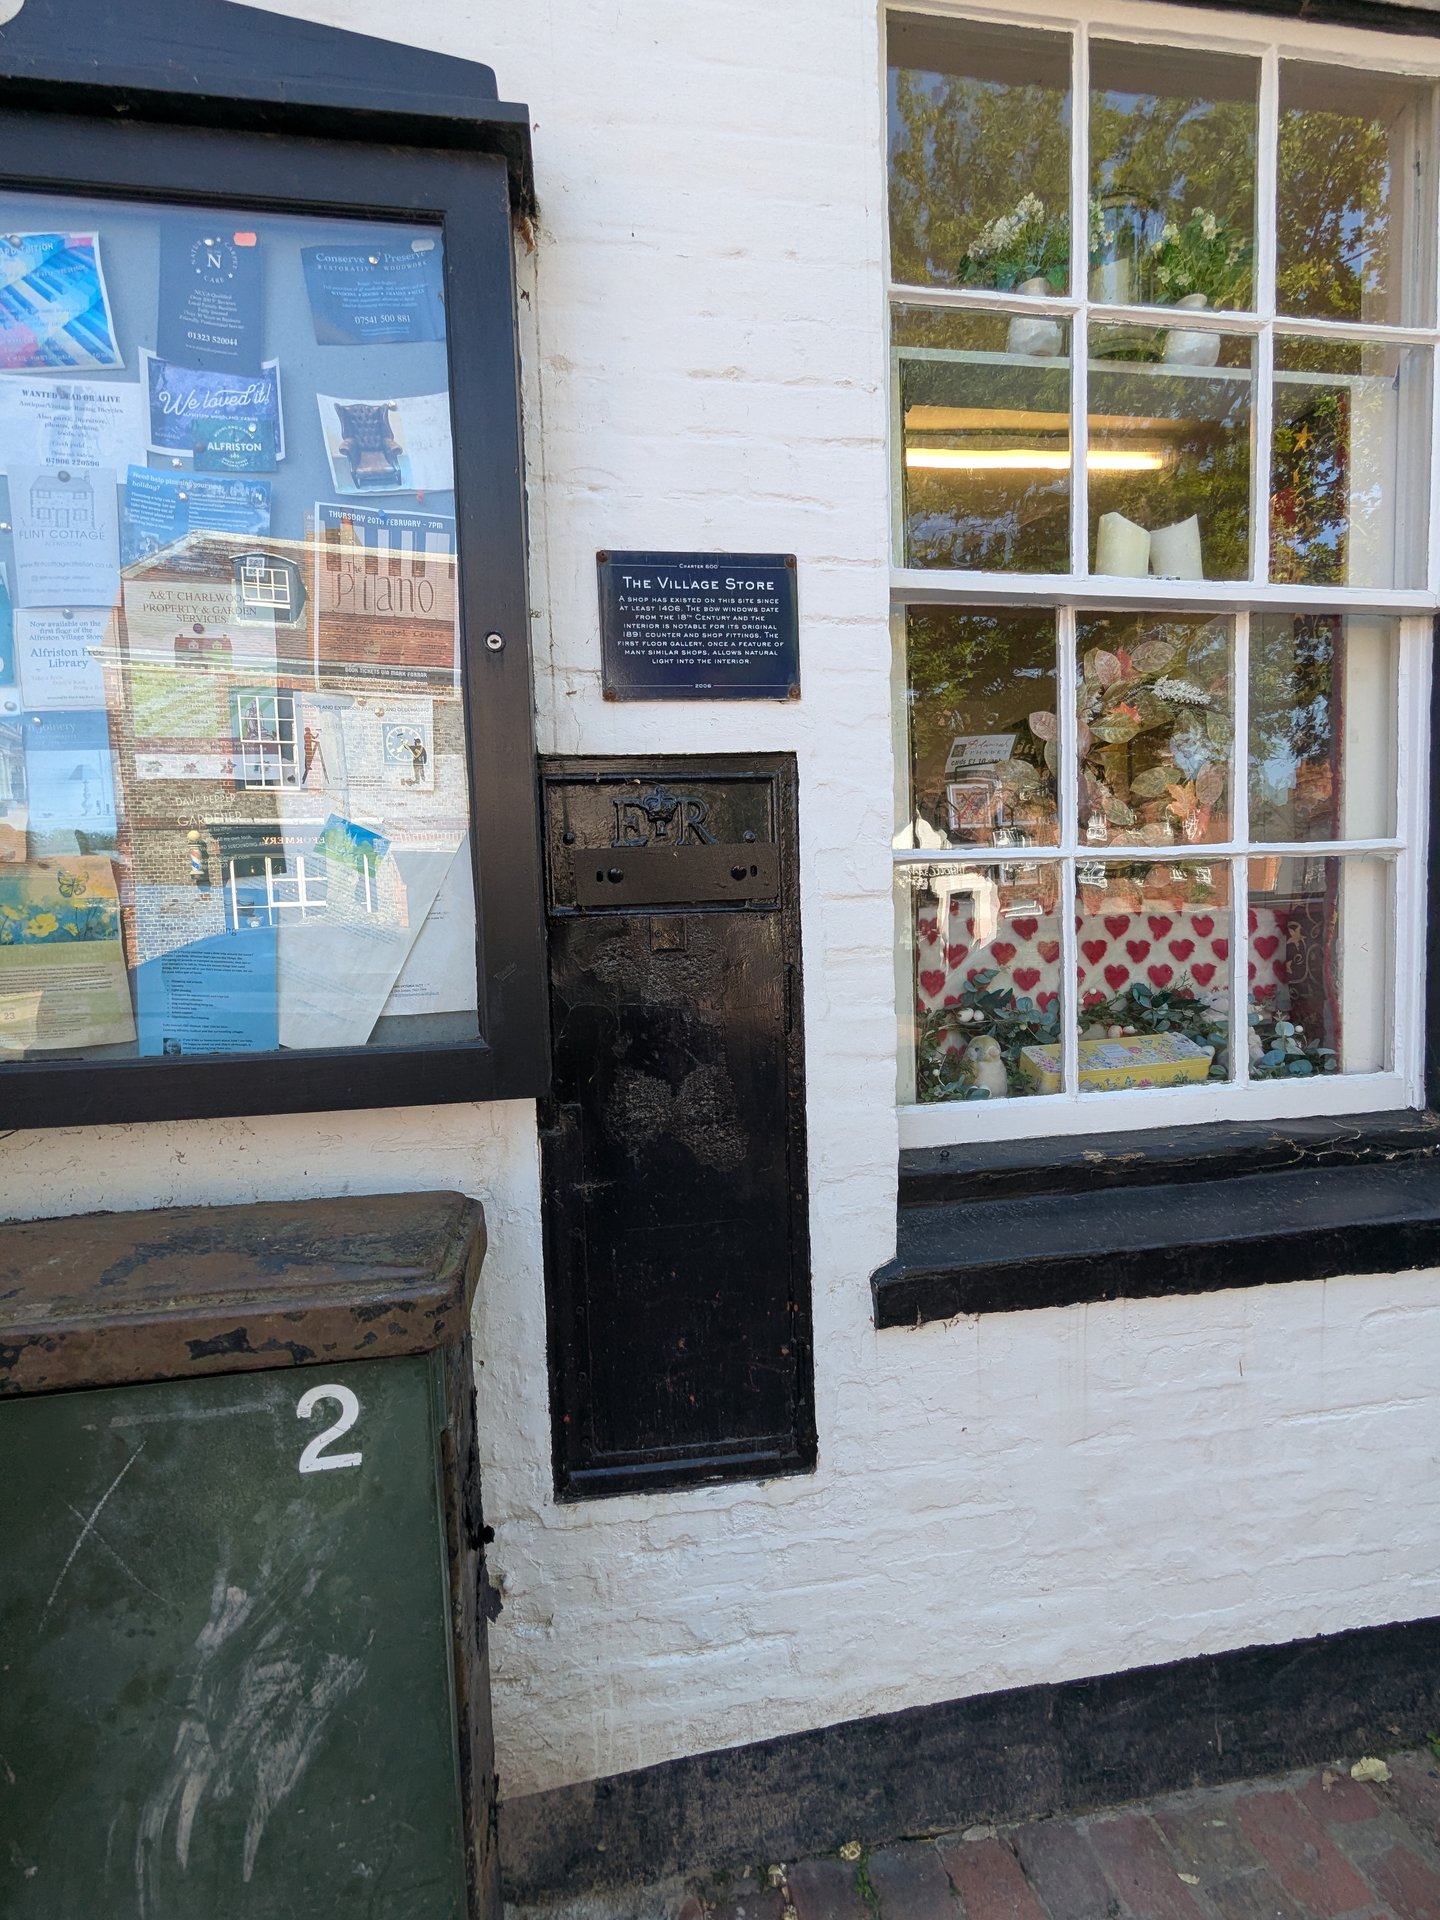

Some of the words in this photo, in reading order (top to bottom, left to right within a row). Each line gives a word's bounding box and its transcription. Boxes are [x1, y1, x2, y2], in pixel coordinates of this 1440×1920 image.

[315, 252, 365, 264] Conserve
[354, 316, 377, 325] 07541
[380, 315, 395, 323] 500
[397, 314, 410, 323] 881
[187, 331, 211, 342] 01323
[212, 334, 238, 347] 520044
[21, 389, 58, 400] WANTED
[97, 394, 121, 403] ALIVE
[159, 389, 201, 416] We
[203, 384, 254, 409] loved
[207, 441, 262, 452] ALFRISTON
[132, 472, 150, 480] Need
[131, 480, 161, 492] holiday?
[328, 510, 366, 522] THURSDAY
[386, 518, 422, 528] FEBRUARY
[428, 521, 444, 529] 7PM
[18, 530, 45, 539] FLINT
[49, 529, 105, 540] COTTAGE
[345, 560, 363, 573] The
[622, 576, 652, 589] THE
[657, 576, 720, 590] VILLAGE
[725, 577, 775, 591] STORE
[336, 573, 434, 613] Piano
[142, 603, 199, 613] PROPERTY
[201, 606, 210, 615] &
[212, 605, 257, 616] GARDEN
[175, 613, 228, 624] SERVICES
[694, 613, 731, 621] CENTURY
[29, 620, 47, 628] Now
[47, 620, 78, 628] available
[61, 634, 85, 642] Village
[764, 631, 779, 639] THE
[30, 648, 79, 657] Alfriston
[49, 659, 89, 669] Library
[175, 794, 200, 807] DAVE
[203, 792, 237, 804] PEPPER
[176, 811, 243, 827] GARDENER
[297, 1384, 362, 1473] 2
